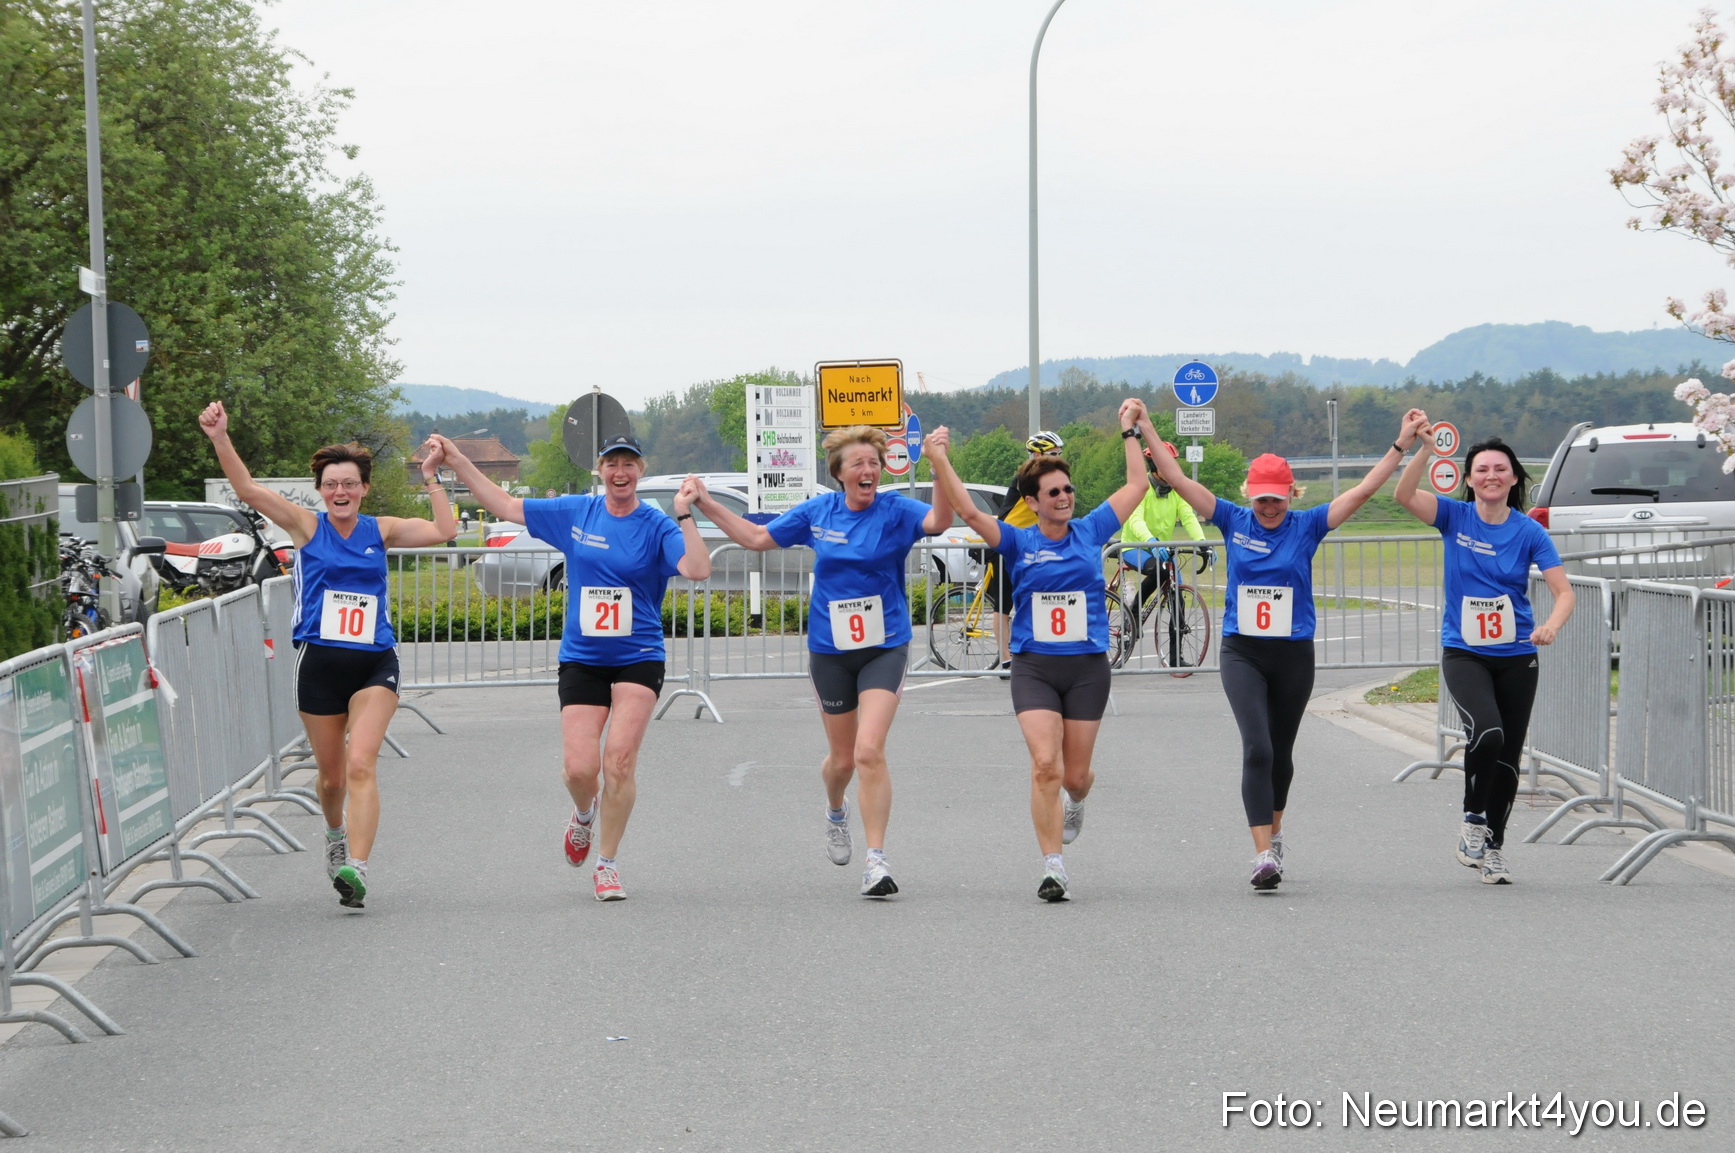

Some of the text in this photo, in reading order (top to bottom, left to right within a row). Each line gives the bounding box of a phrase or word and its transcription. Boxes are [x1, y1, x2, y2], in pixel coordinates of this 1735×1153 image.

[849, 375, 871, 383] Nach
[828, 387, 892, 403] Neumarkt
[1436, 432, 1452, 446] 60
[763, 473, 785, 488] THULE
[338, 607, 364, 636] 10
[595, 602, 618, 630] 21
[849, 614, 865, 642] 9
[1051, 607, 1066, 636] 8
[1256, 601, 1270, 630] 6
[1476, 612, 1502, 639] 13
